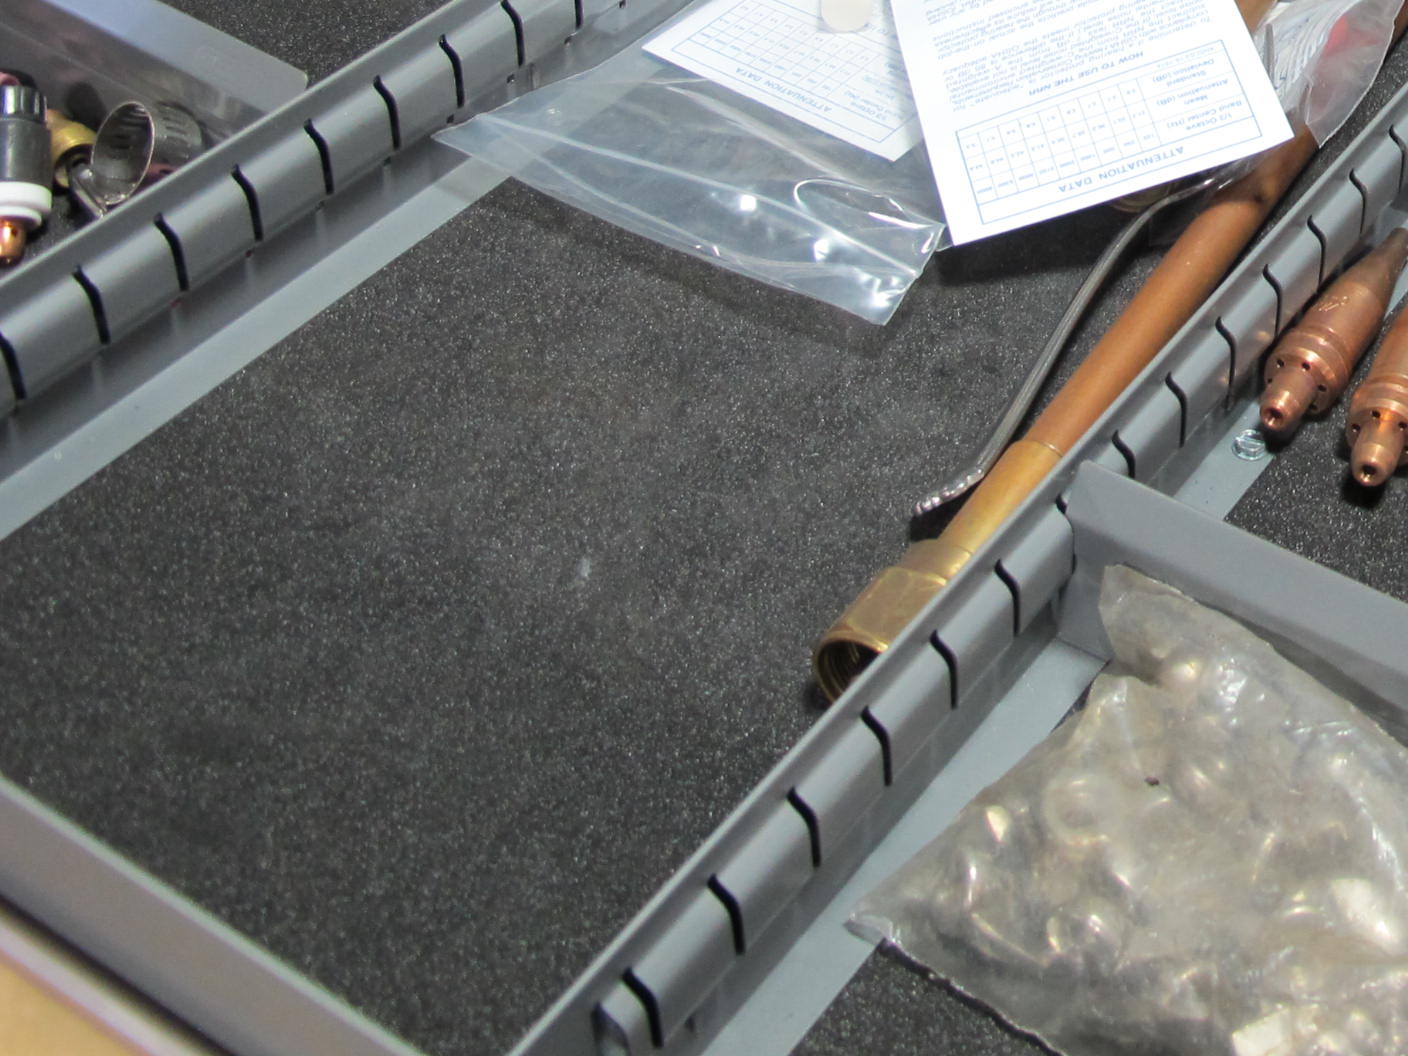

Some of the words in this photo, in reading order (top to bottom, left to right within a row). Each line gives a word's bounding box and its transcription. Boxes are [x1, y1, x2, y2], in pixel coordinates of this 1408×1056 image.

[1099, 60, 1115, 70] TO
[1117, 50, 1144, 64] HOW
[735, 65, 764, 84] DATA
[1053, 75, 1074, 87] THE
[1176, 77, 1228, 99] Attenuation
[1097, 145, 1184, 180] ATTENUATION
[1057, 176, 1092, 193] DATA
